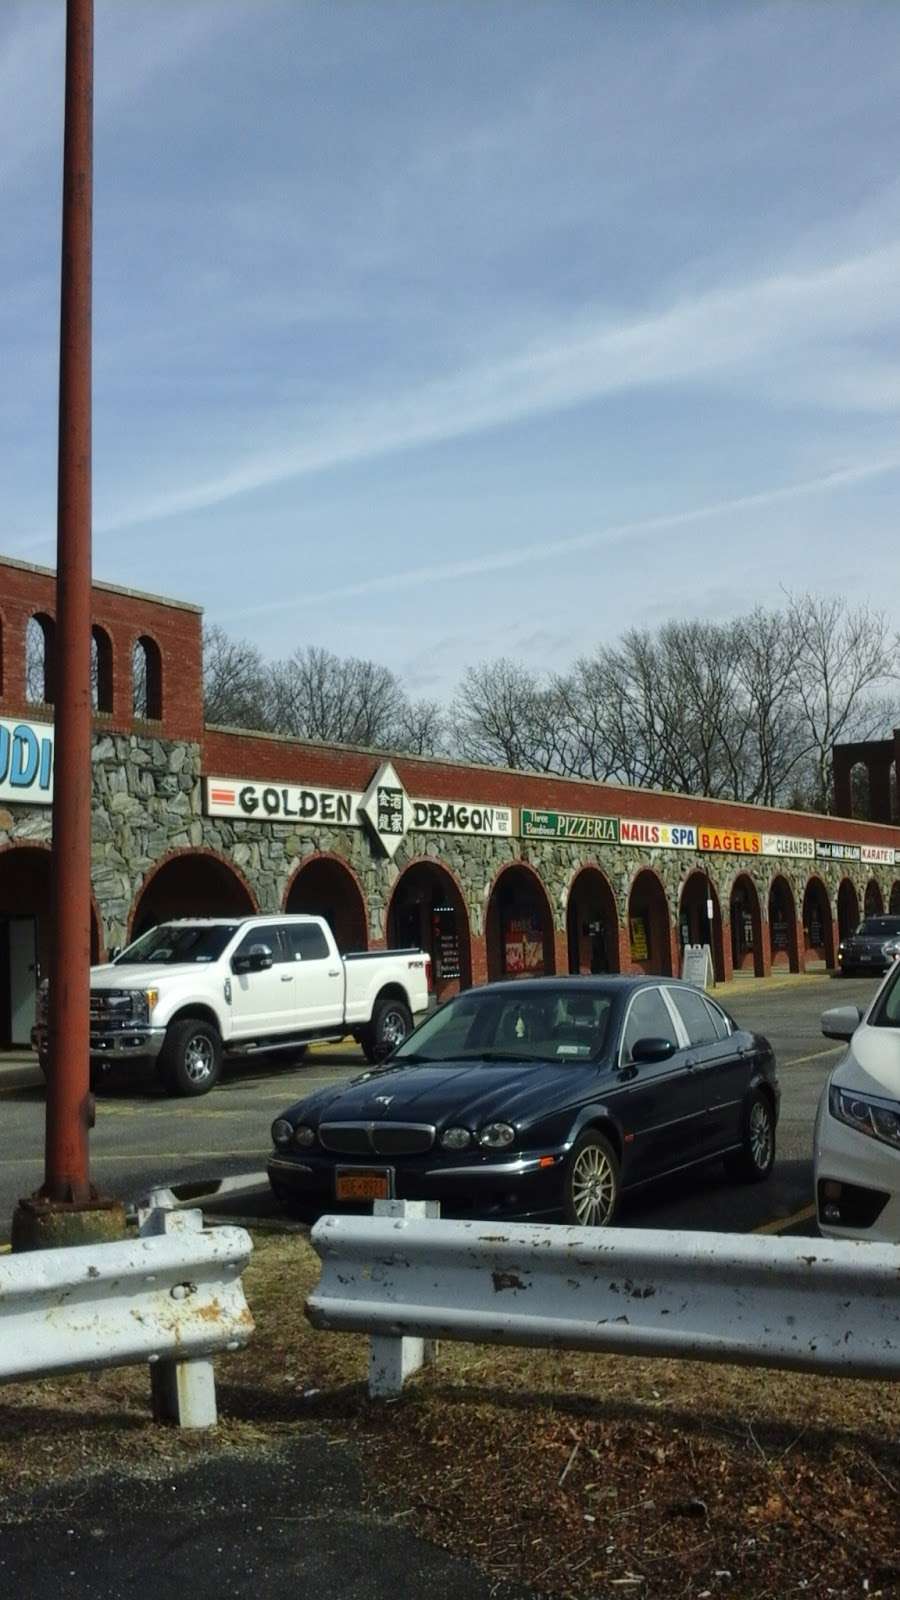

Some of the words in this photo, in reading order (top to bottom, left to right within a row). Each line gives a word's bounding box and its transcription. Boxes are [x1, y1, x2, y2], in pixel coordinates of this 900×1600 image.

[239, 786, 352, 821] GOLDEN
[413, 803, 494, 831] DRAGON
[556, 815, 616, 839] PIZZERIA
[621, 823, 659, 843] NAILS
[671, 828, 695, 846] SPA
[702, 834, 759, 852] BAGELS
[776, 839, 813, 855] CLEANERS
[862, 849, 888, 861] KARATE
